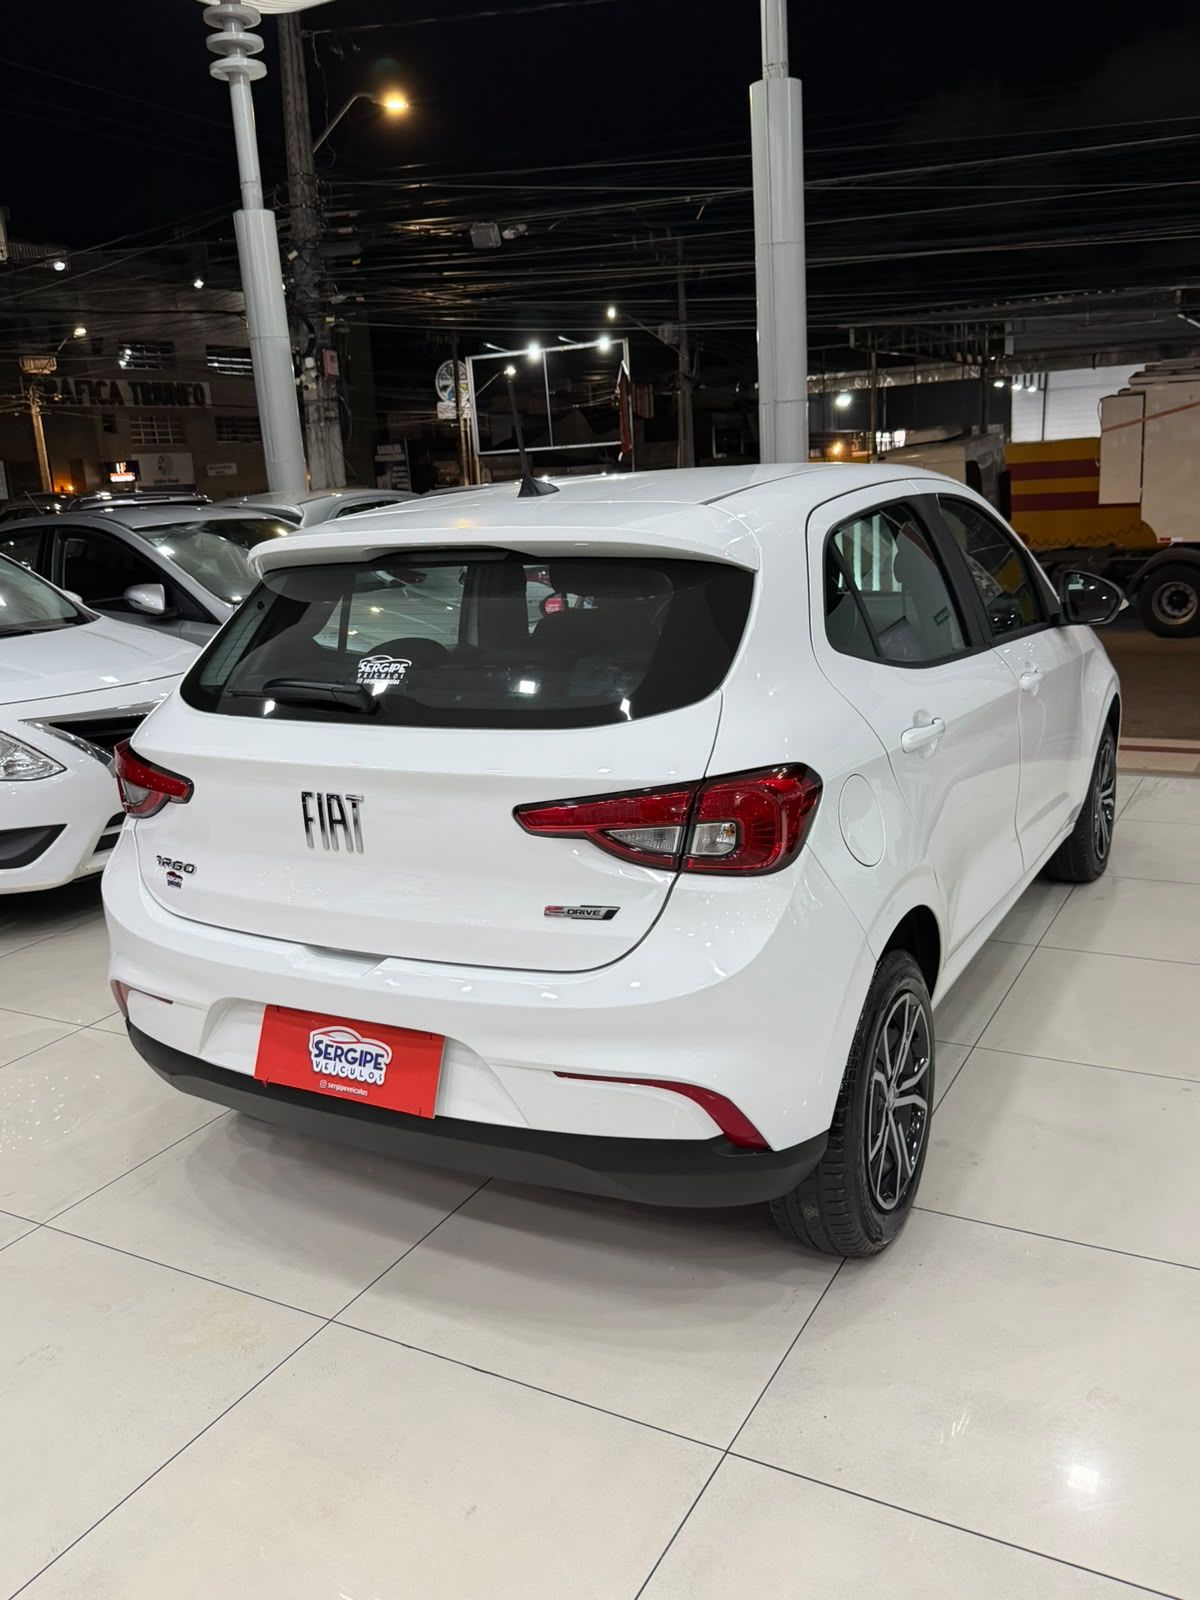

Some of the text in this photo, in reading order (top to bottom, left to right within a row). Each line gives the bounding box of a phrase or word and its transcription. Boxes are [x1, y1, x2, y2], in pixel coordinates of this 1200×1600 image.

[358, 661, 409, 674] SERGIPE
[301, 791, 364, 854] FIAT
[156, 855, 197, 874] ARGO
[314, 1039, 385, 1071] SERGIPE
[315, 1060, 383, 1082] VEÍCULOS
